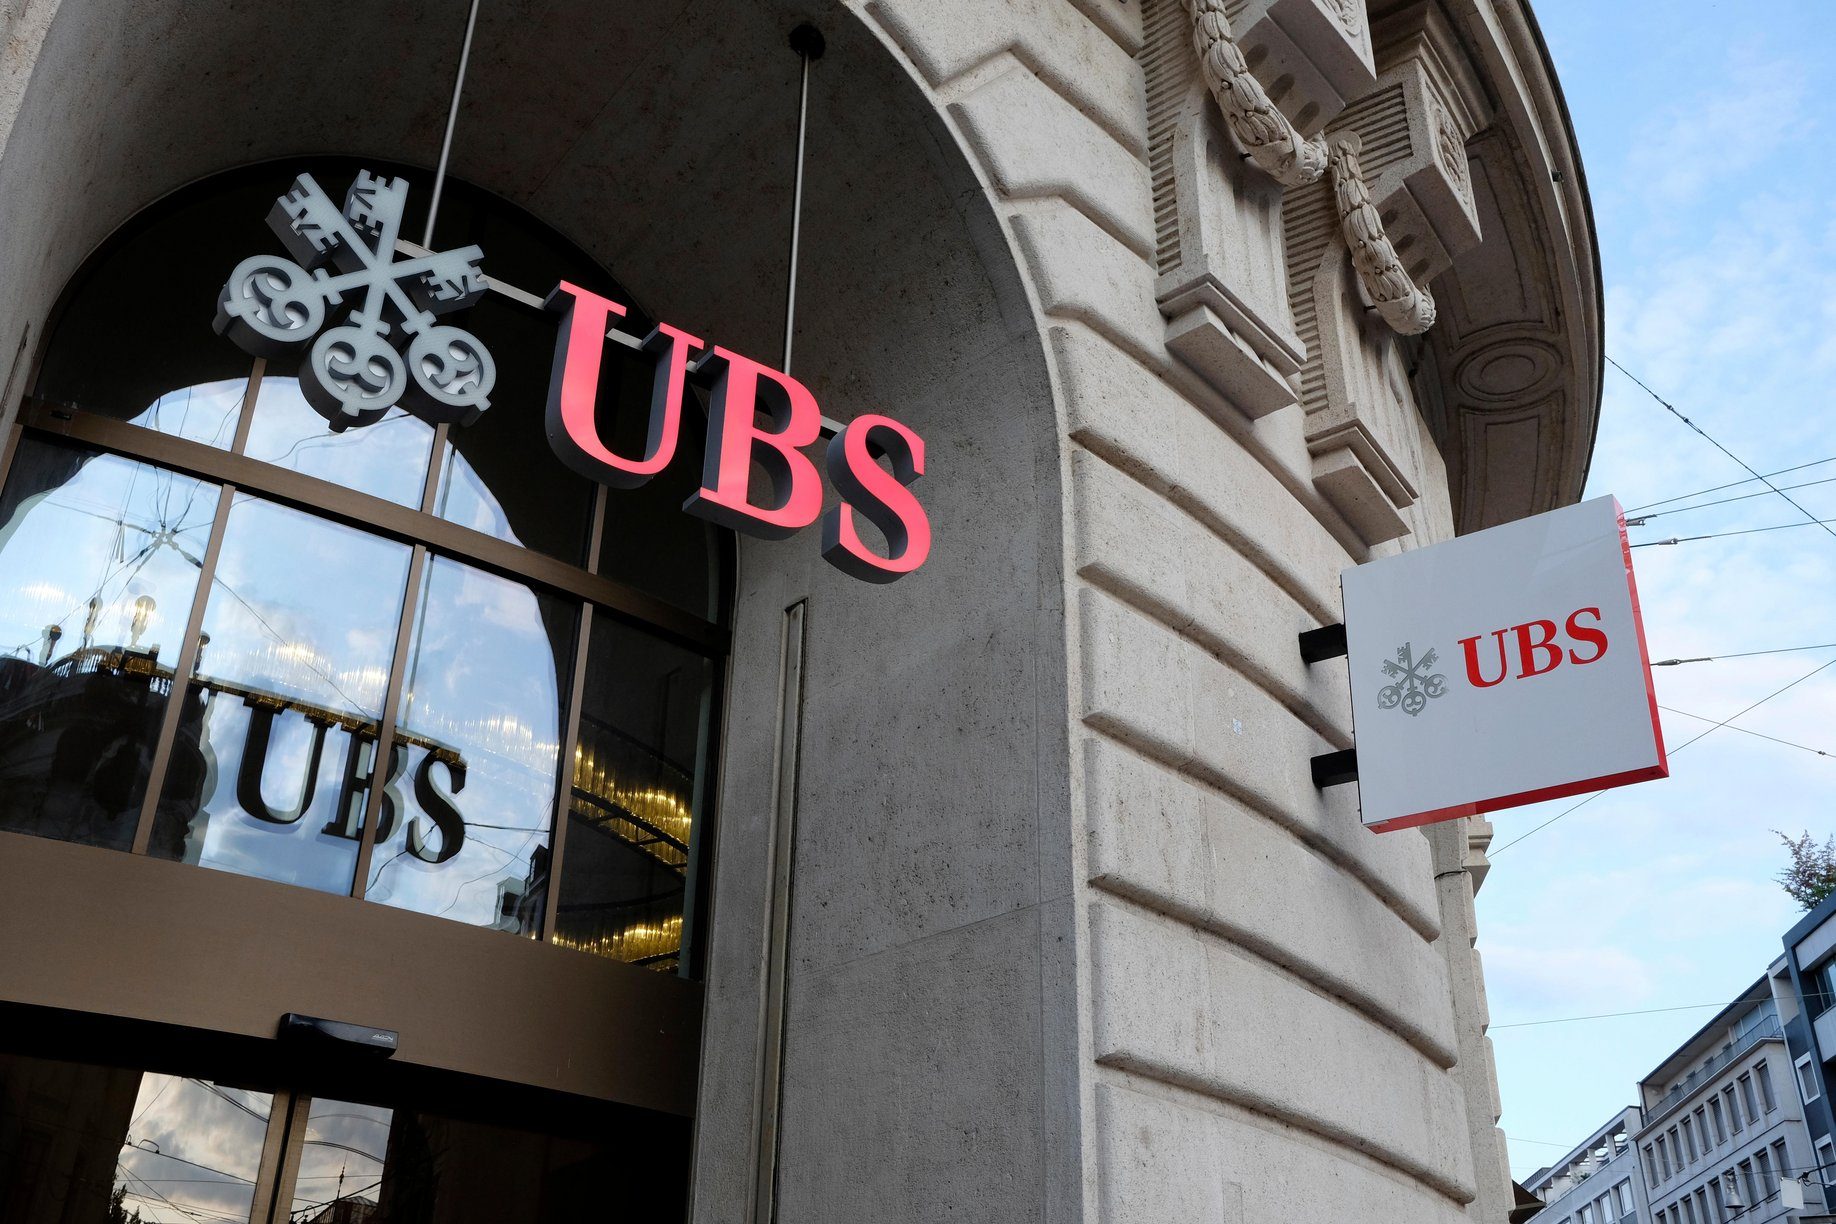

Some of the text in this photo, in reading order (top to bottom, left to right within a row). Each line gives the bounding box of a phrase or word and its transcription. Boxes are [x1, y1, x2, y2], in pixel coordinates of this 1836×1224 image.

[556, 279, 932, 574] UBS
[1457, 607, 1609, 688] UBS
[237, 697, 467, 864] UBS
